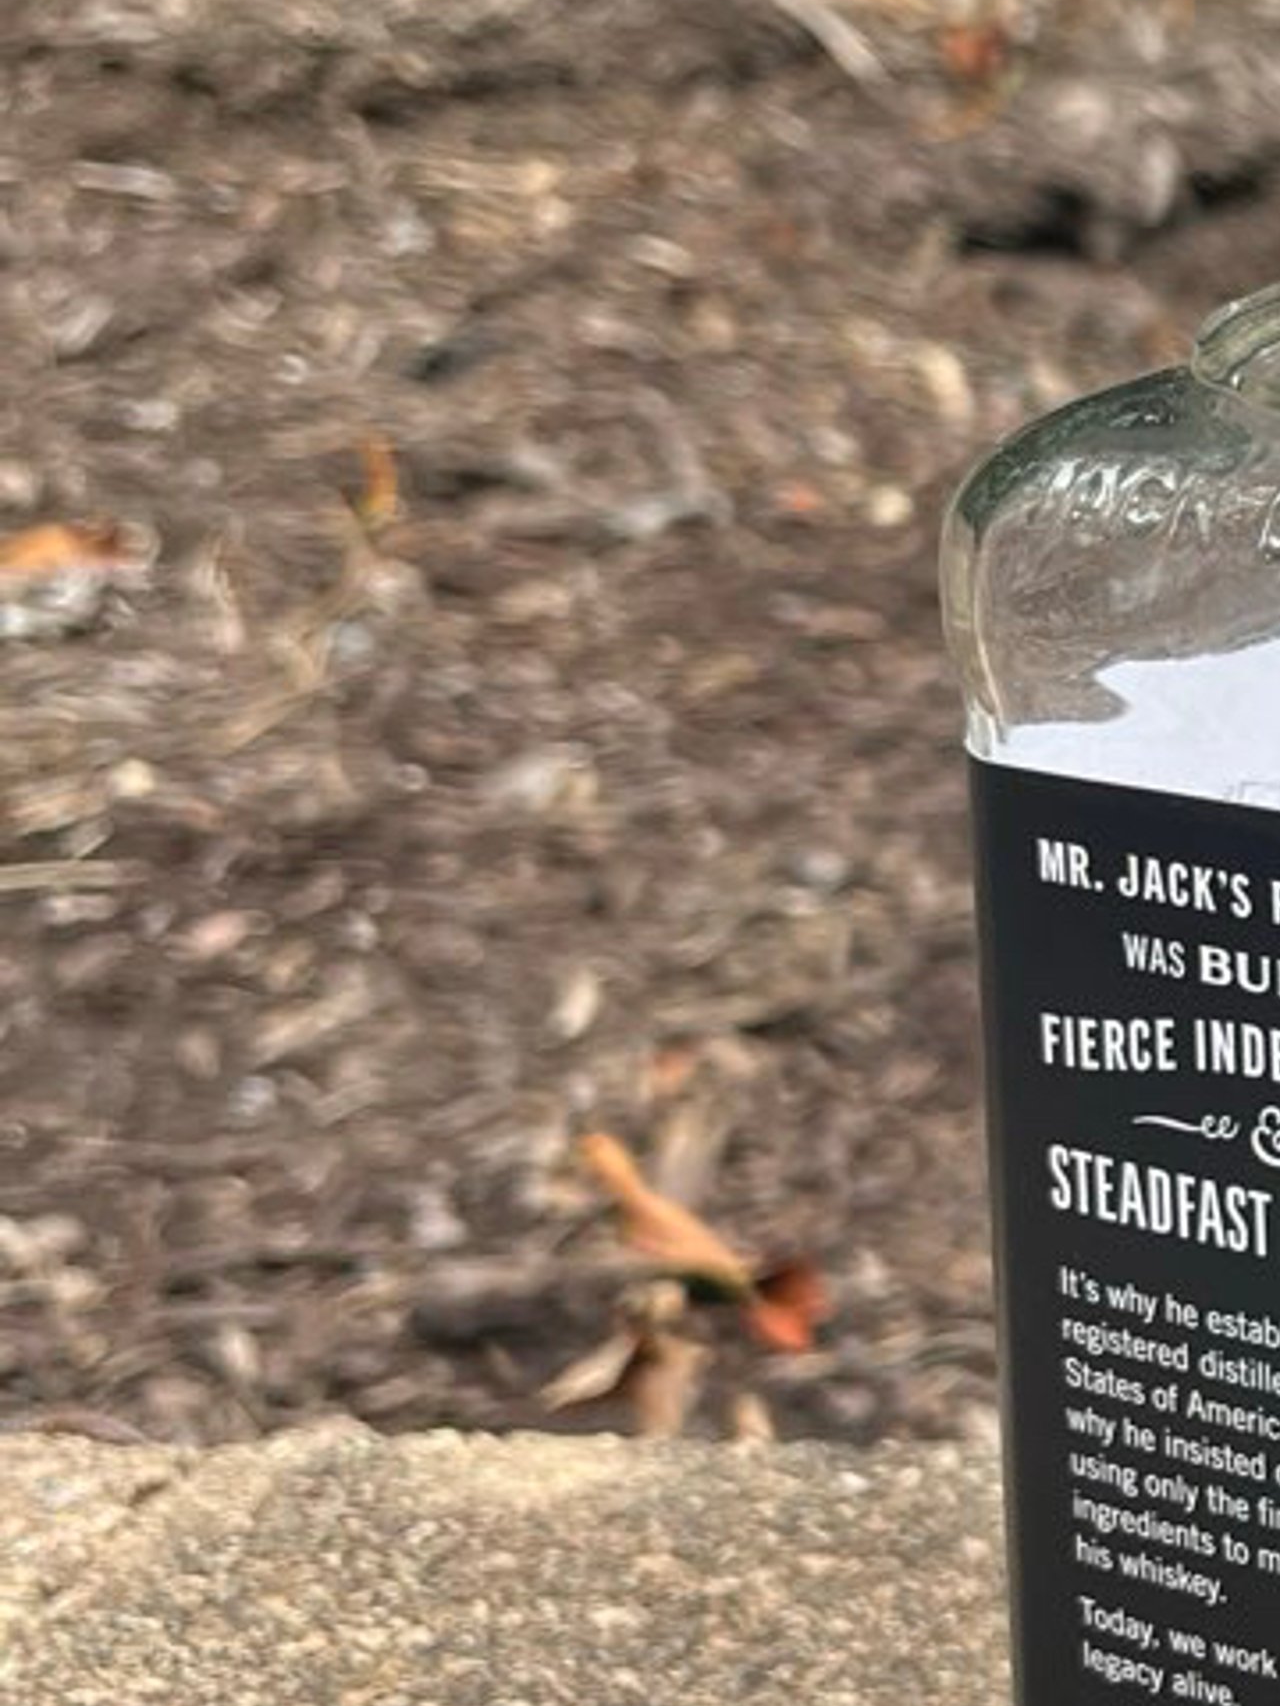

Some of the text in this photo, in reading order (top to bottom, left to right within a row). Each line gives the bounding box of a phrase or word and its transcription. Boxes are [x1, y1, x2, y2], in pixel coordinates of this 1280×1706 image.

[1037, 838, 1105, 891] MR.
[1118, 853, 1252, 919] JACK'S
[1122, 932, 1186, 979] WAS
[1040, 1012, 1177, 1072] FIERCE
[1048, 1144, 1272, 1258] STEADFAST
[1060, 1265, 1100, 1302] It's
[1107, 1285, 1156, 1323] why
[1165, 1291, 1198, 1328] he
[1062, 1315, 1189, 1371] registered
[1065, 1358, 1145, 1405] States
[1152, 1383, 1179, 1412] of
[1066, 1408, 1116, 1448] why
[1123, 1413, 1156, 1451] he
[1165, 1425, 1266, 1483] insisted
[1070, 1454, 1138, 1497] using
[1145, 1468, 1198, 1511] only
[1206, 1478, 1250, 1521] the
[1072, 1491, 1215, 1555] ingredients
[1222, 1533, 1250, 1565] to
[1075, 1535, 1228, 1605] his whiskey.
[1080, 1597, 1160, 1649] Today,
[1169, 1627, 1206, 1657] we
[1214, 1635, 1278, 1679] work
[1082, 1641, 1164, 1694] legacy
